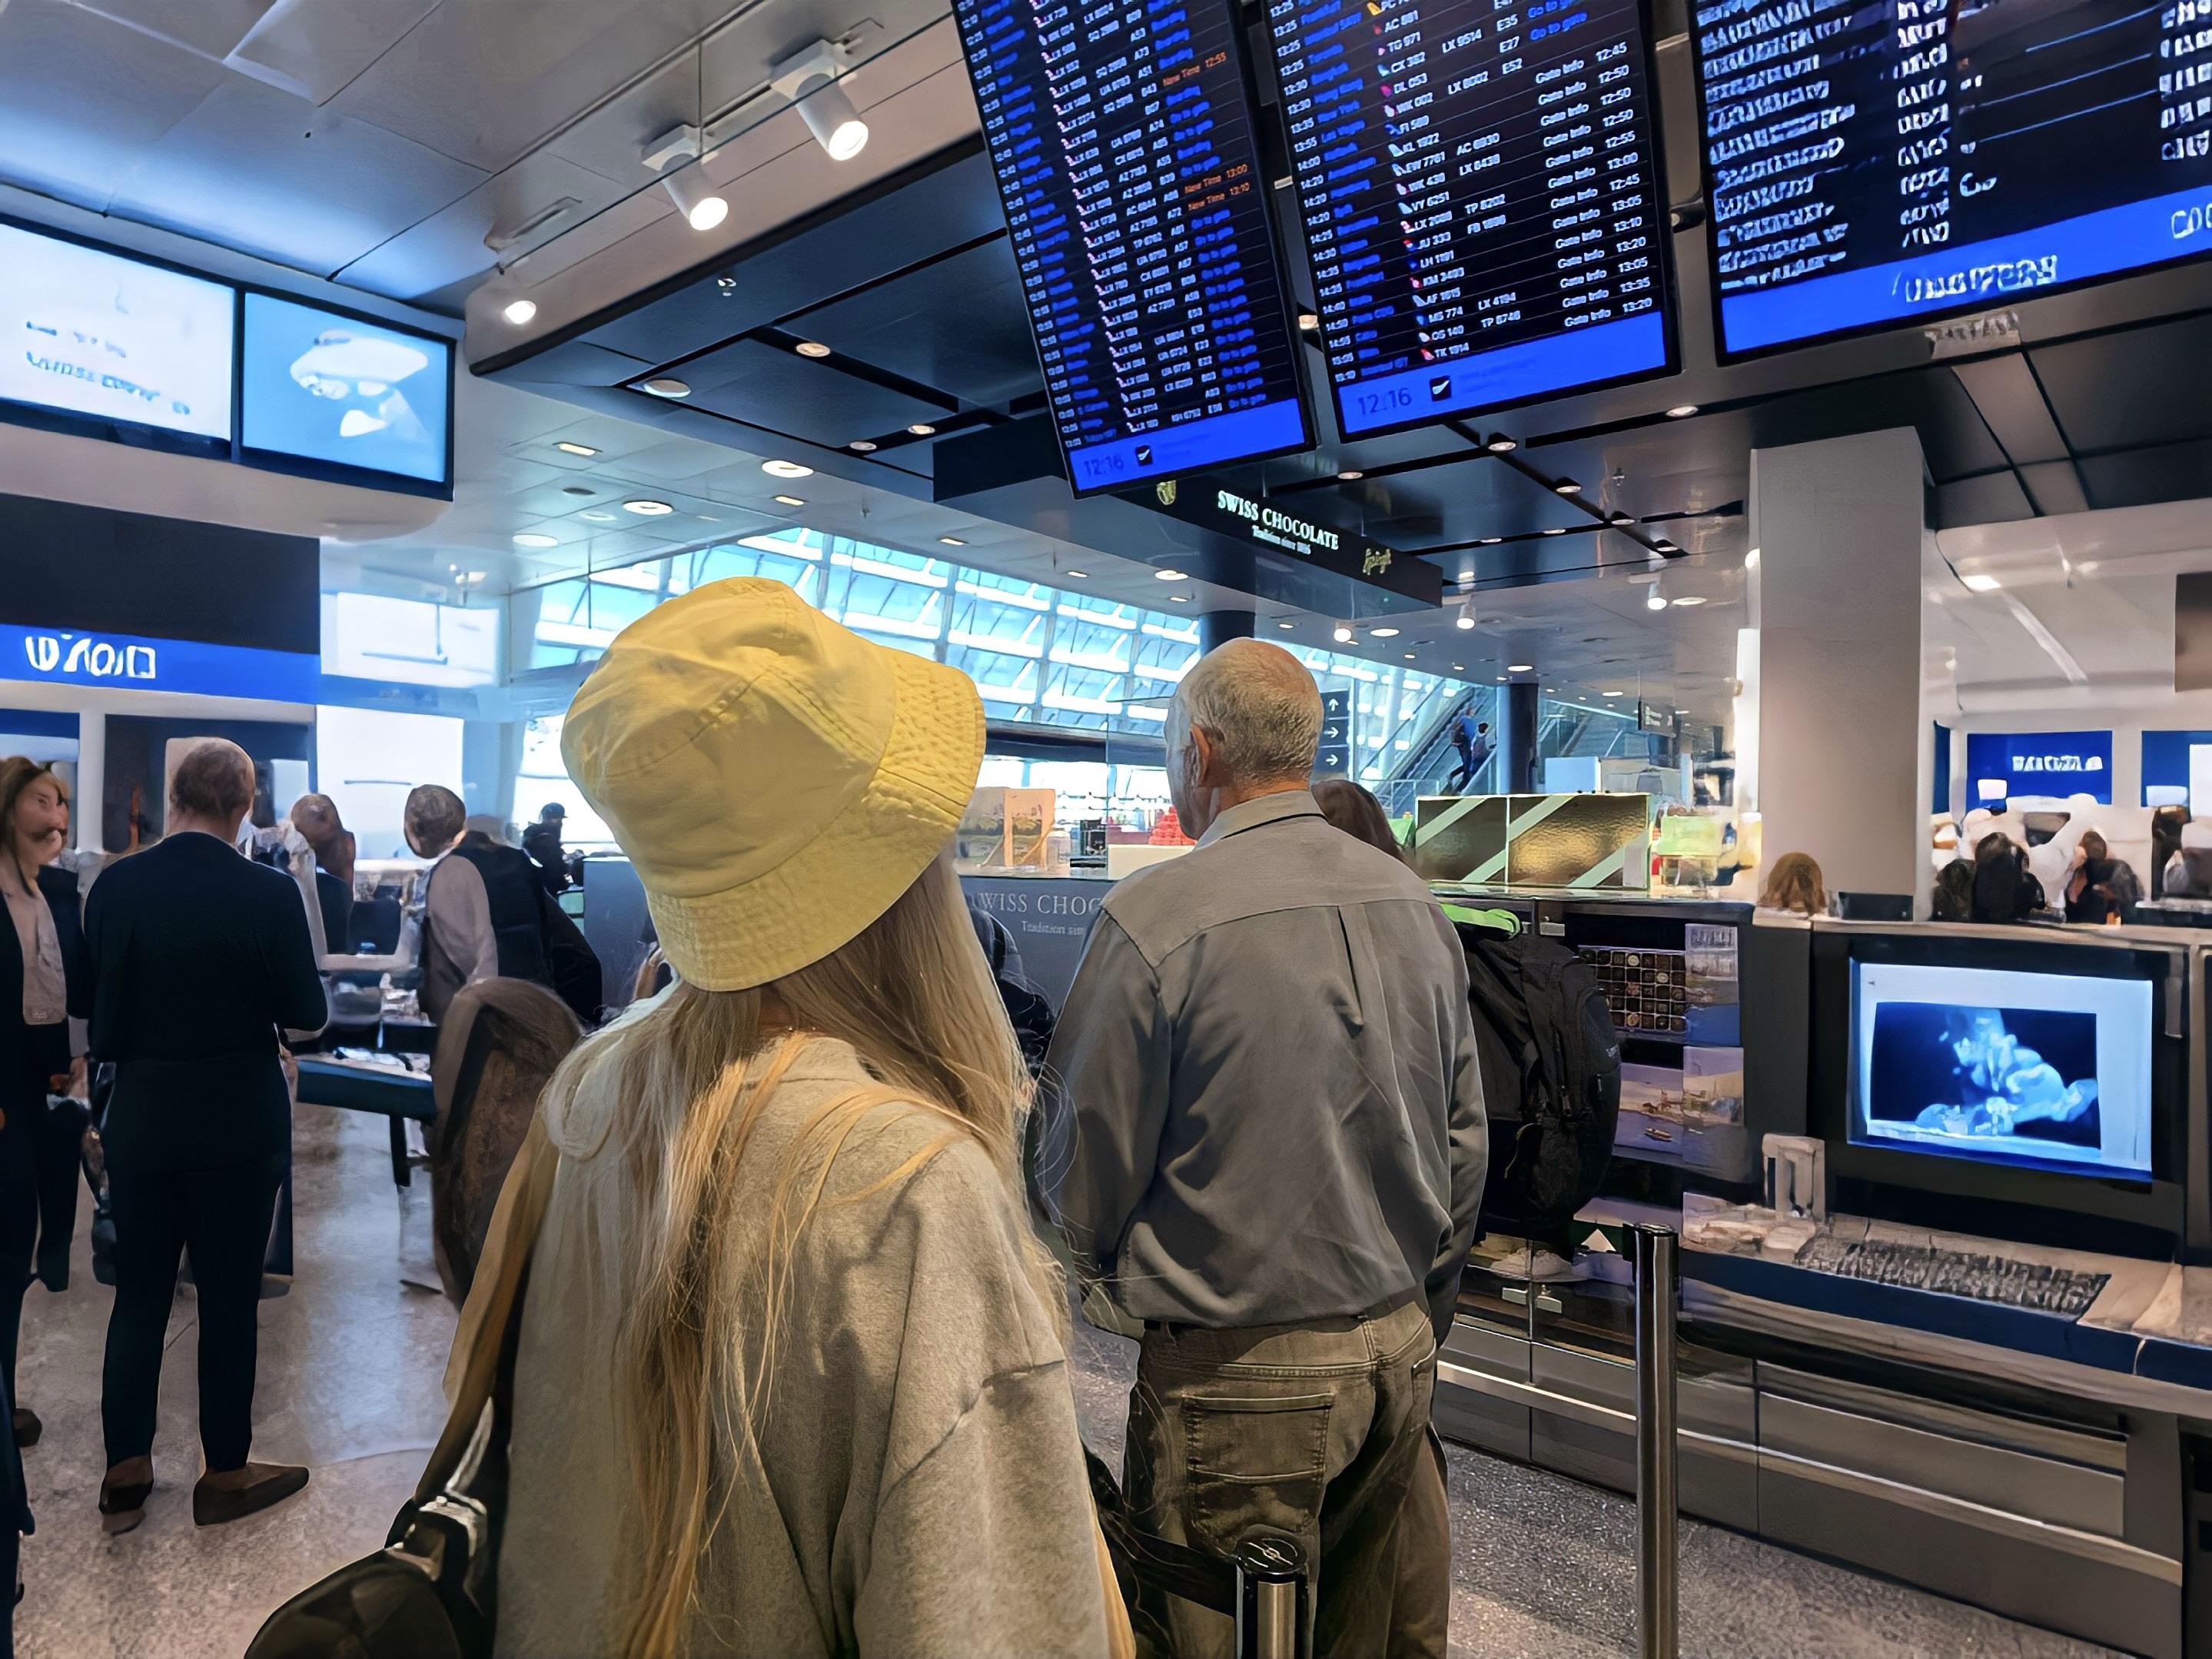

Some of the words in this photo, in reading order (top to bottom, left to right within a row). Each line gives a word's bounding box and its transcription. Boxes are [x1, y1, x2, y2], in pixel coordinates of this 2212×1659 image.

[1442, 39, 1456, 53] LX
[1497, 14, 1518, 32] E35
[1596, 42, 1626, 62] 12:45
[1599, 65, 1629, 83] 12:50
[1448, 81, 1462, 95] LX
[1600, 88, 1631, 105] 12:50
[1603, 109, 1633, 127] 12:50
[1606, 131, 1635, 148] 12:55
[1610, 174, 1639, 191] 12:45
[1614, 217, 1642, 231] 13:10
[1616, 237, 1646, 252] 13:20
[1217, 490, 1259, 521] SWISS
[1262, 508, 1339, 550] CHOCOLATE
[976, 893, 1028, 913] WISS
